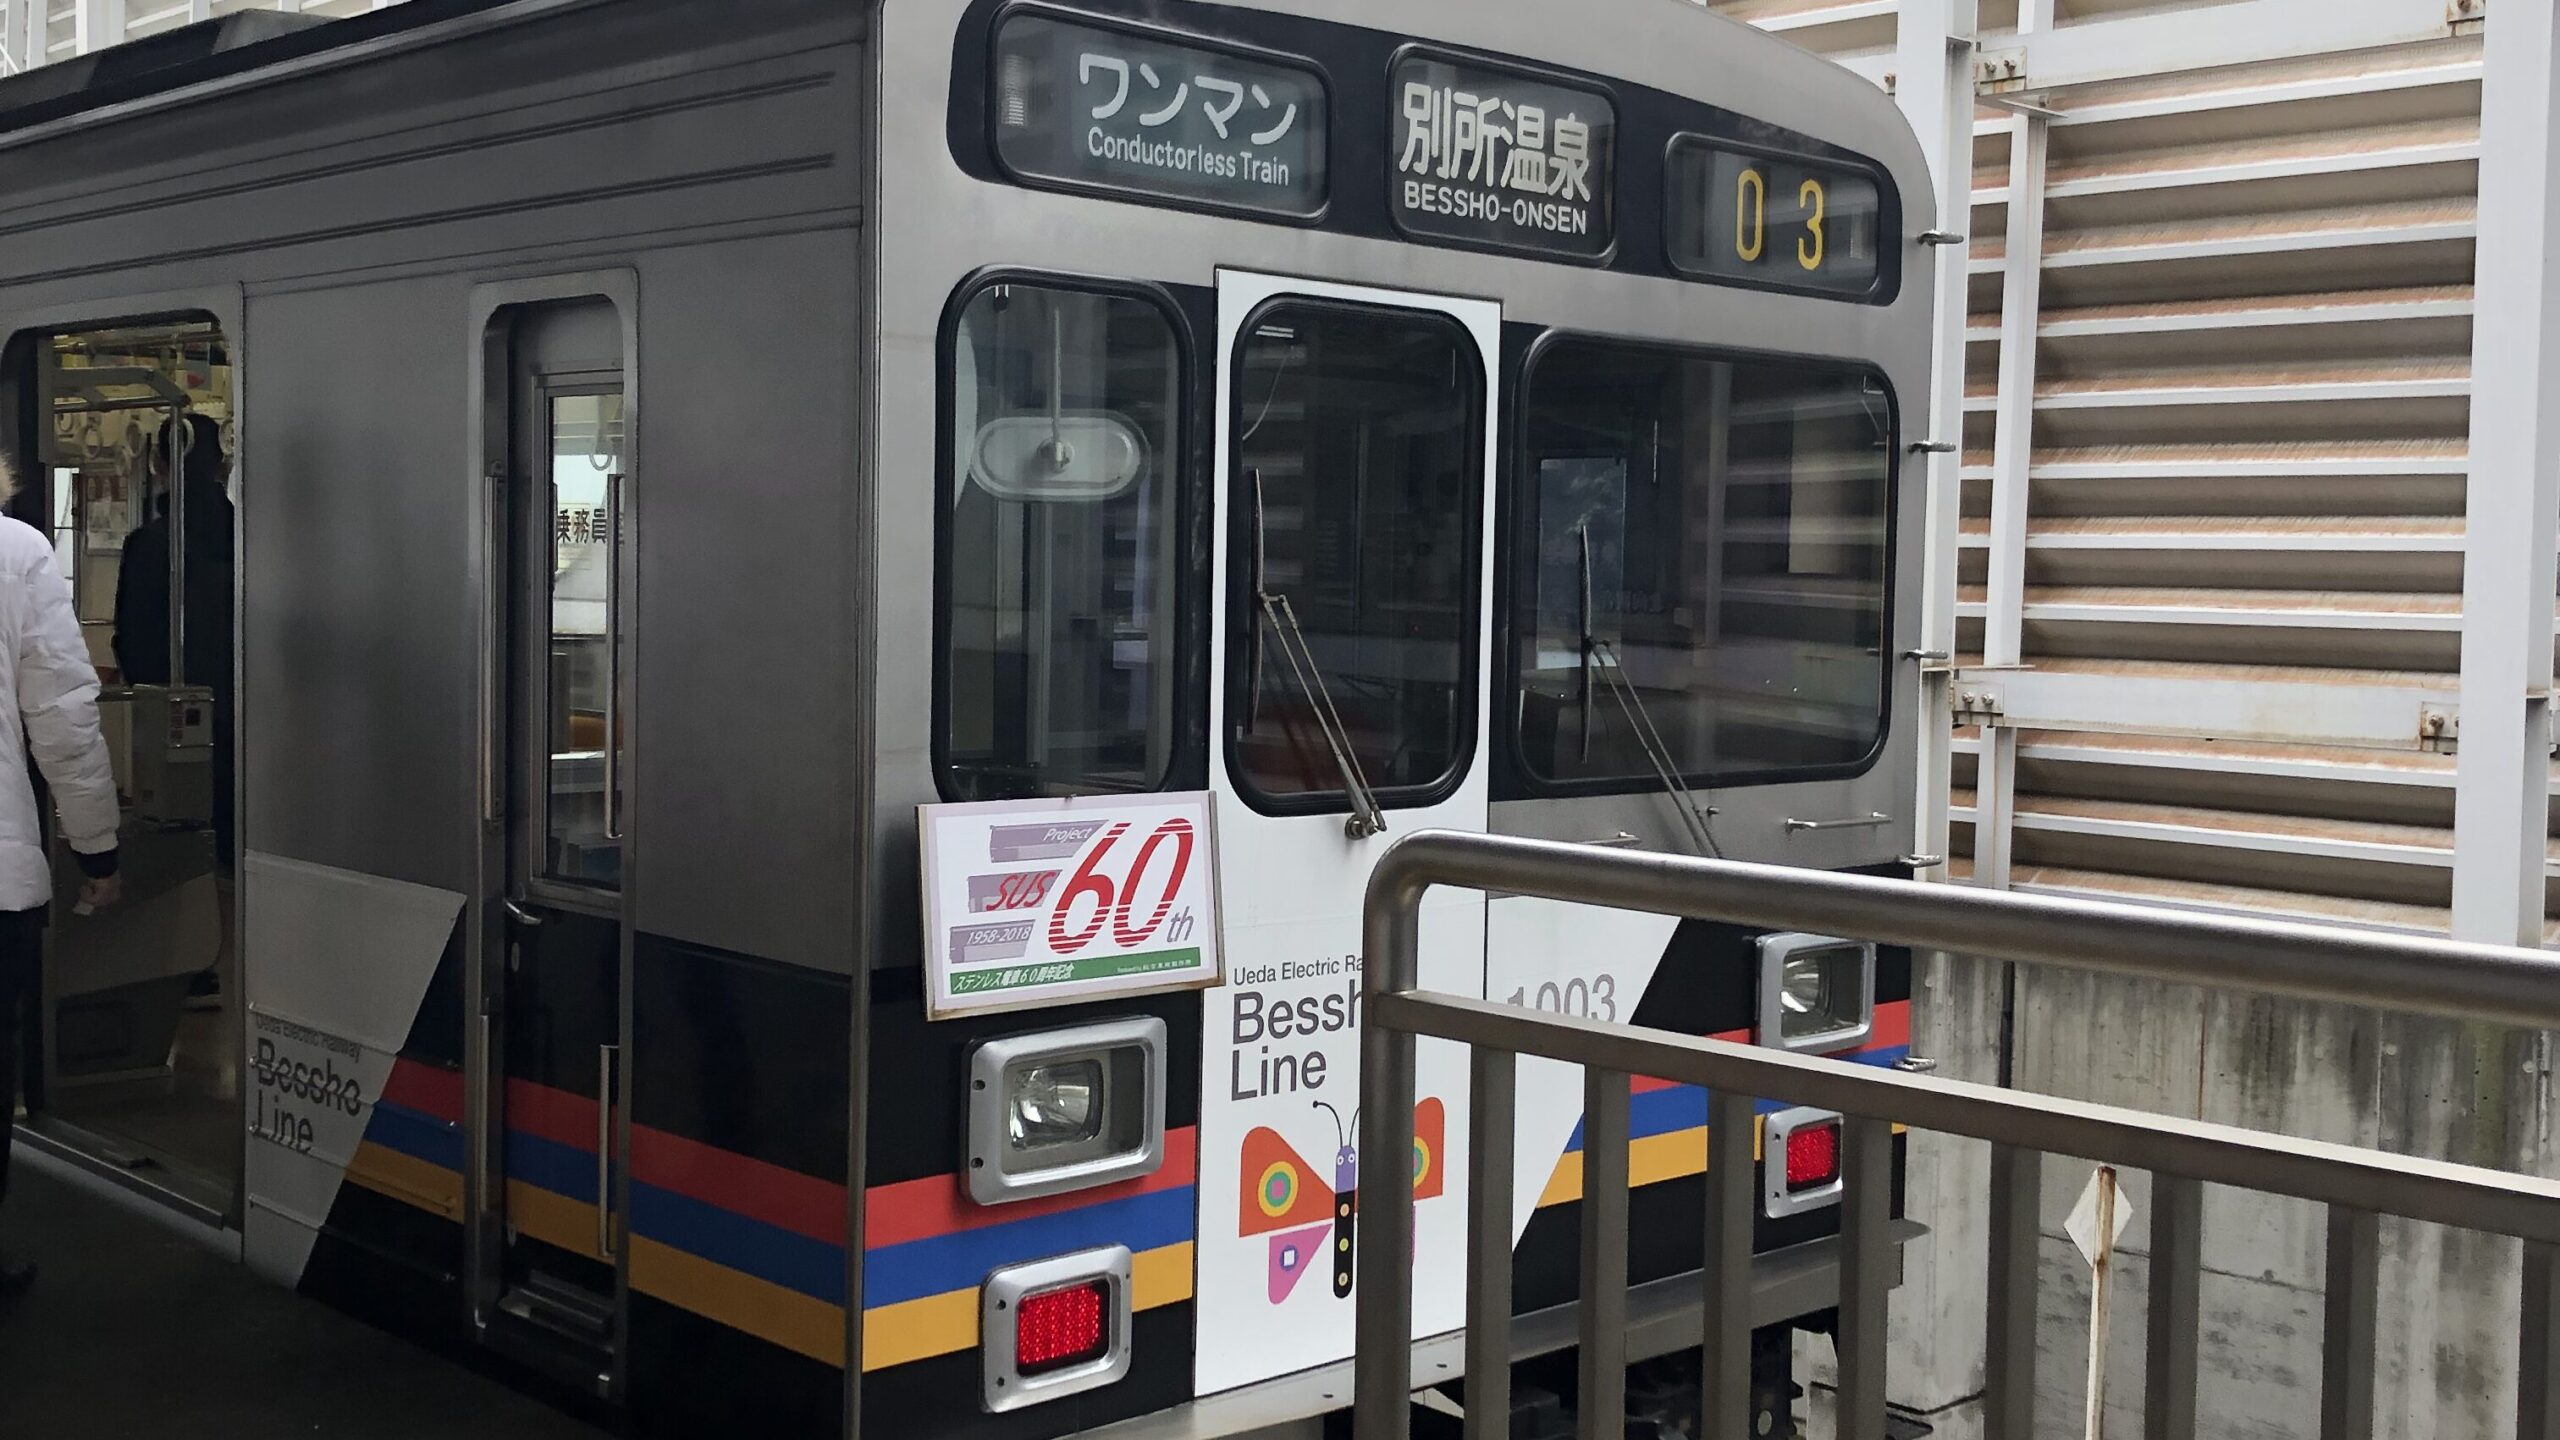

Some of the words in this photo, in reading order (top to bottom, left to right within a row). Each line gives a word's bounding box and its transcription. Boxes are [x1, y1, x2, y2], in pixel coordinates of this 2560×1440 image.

[1079, 52, 1297, 145] ワンマン
[1087, 126, 1237, 178] Conductorless
[1239, 150, 1290, 187] Train
[1398, 81, 1591, 203] 別所温泉
[1404, 180, 1587, 236] BESSHO-ONSEN
[557, 508, 624, 545] 乗務員
[1042, 825, 1092, 843] Project
[985, 870, 1057, 912] SUS
[966, 926, 1032, 946] 1958-2018
[1233, 964, 1277, 986] Ueda
[1281, 957, 1340, 981] Electric
[257, 1036, 361, 1118] Bessho
[1231, 1045, 1327, 1102] Line
[255, 1089, 315, 1155] Line
